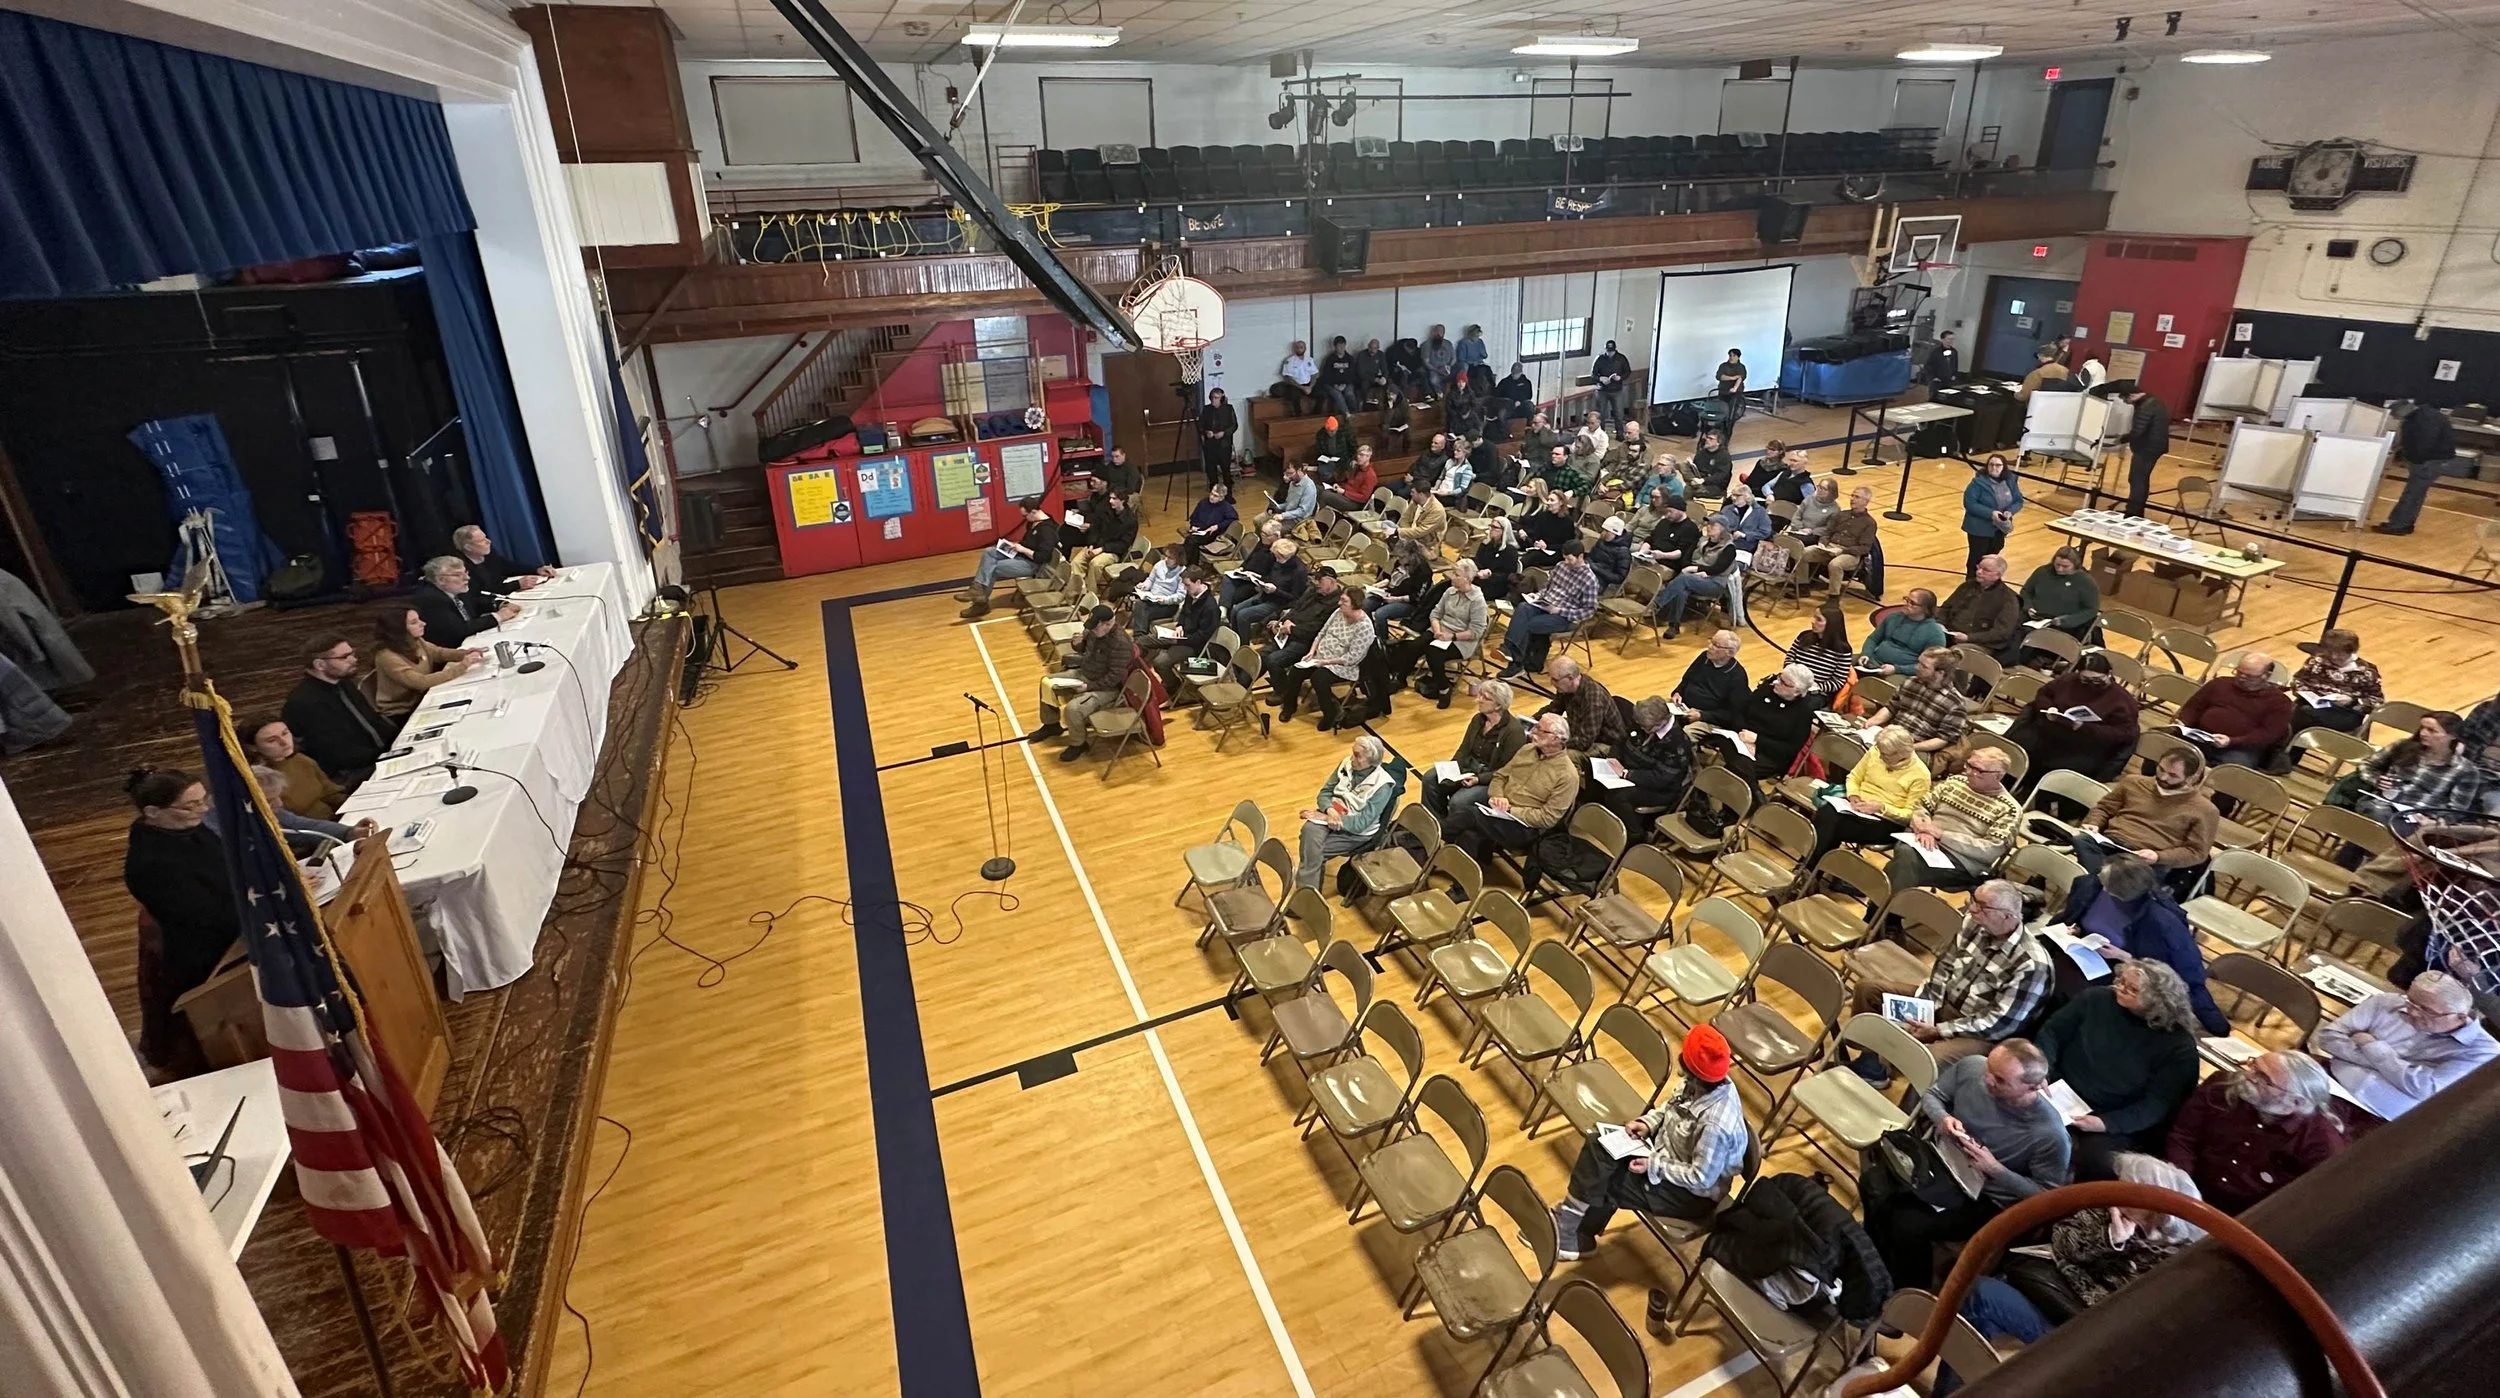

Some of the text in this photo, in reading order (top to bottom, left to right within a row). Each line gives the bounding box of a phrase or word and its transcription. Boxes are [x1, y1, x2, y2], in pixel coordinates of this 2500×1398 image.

[1555, 197, 1567, 209] BE
[1188, 218, 1200, 231] BE
[860, 472, 874, 482] Dd
